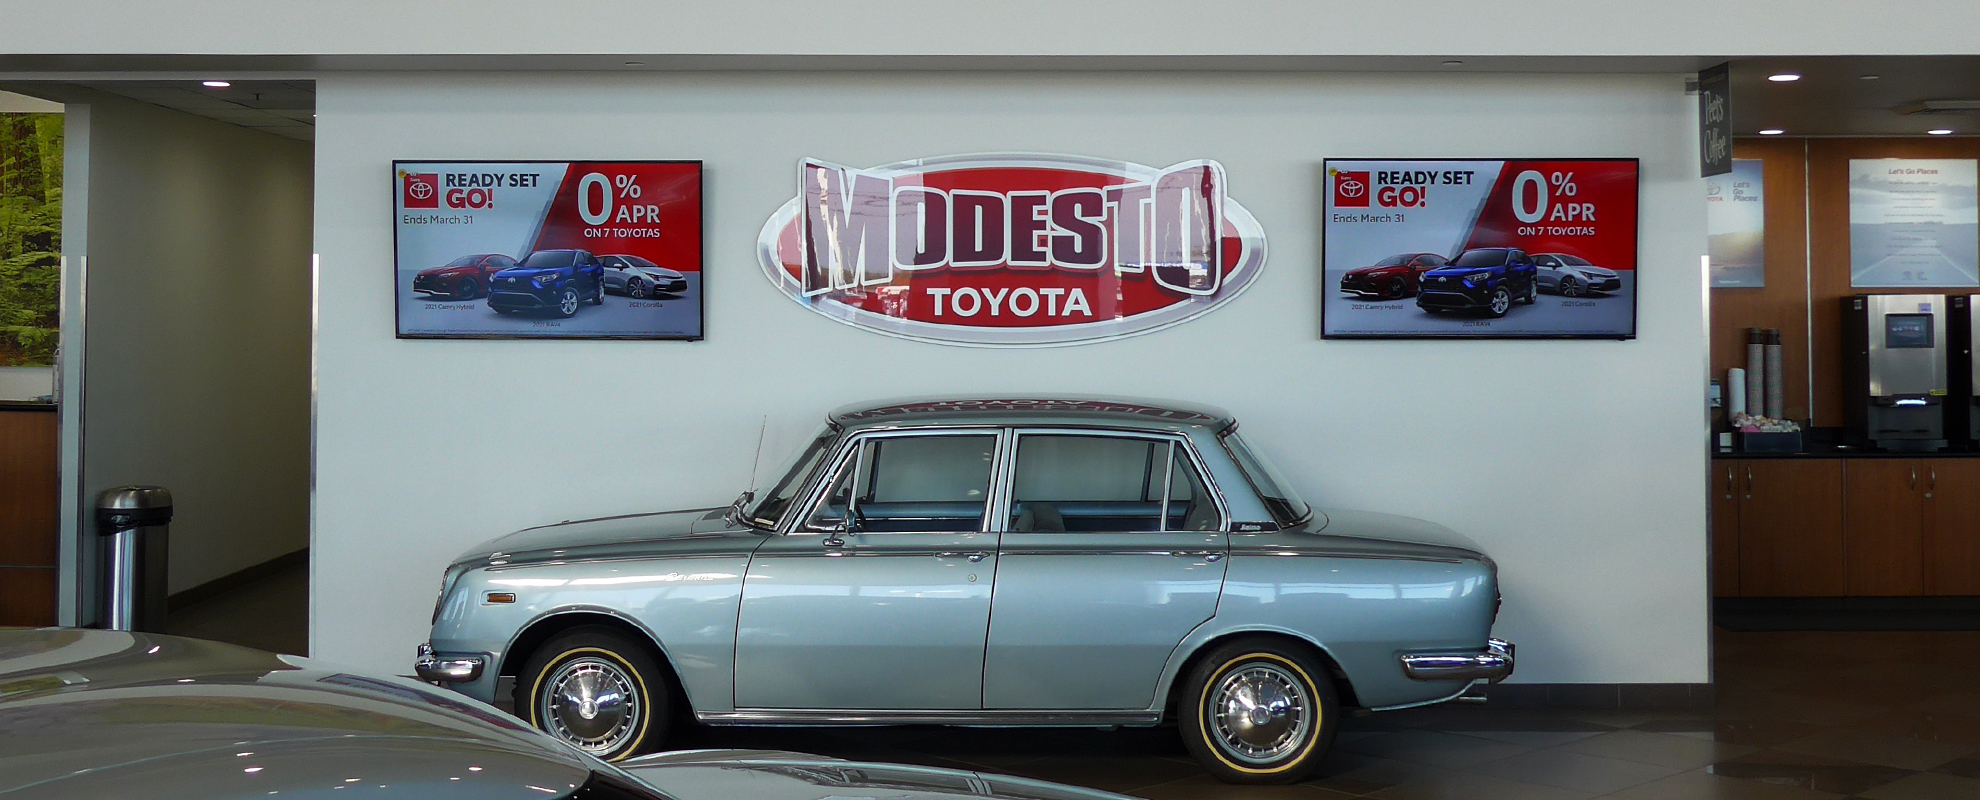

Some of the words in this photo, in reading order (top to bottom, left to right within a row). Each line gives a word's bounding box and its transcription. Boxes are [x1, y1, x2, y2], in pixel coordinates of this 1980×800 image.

[1704, 127, 1726, 166] Coffee
[445, 173, 505, 187] READY
[508, 173, 540, 187] SET
[1377, 171, 1438, 185] READY
[1442, 171, 1475, 185] SET
[445, 188, 493, 209] GO!
[1377, 186, 1426, 208] GO!
[403, 215, 428, 224] Ends
[430, 215, 460, 224] March
[464, 215, 473, 224] 31
[616, 205, 660, 223] APR
[1333, 214, 1358, 223] Ends
[1361, 213, 1392, 223] March
[1395, 214, 1405, 223] 31
[1550, 203, 1596, 221] APR
[584, 228, 601, 238] ON
[604, 228, 610, 238] 7
[613, 228, 660, 238] TOYOTAS
[801, 157, 1225, 298] MODESTO
[1517, 226, 1536, 236] ON
[1537, 226, 1544, 236] 7
[1547, 226, 1595, 236] TOYOTAS
[926, 287, 1092, 316] TOYOTA
